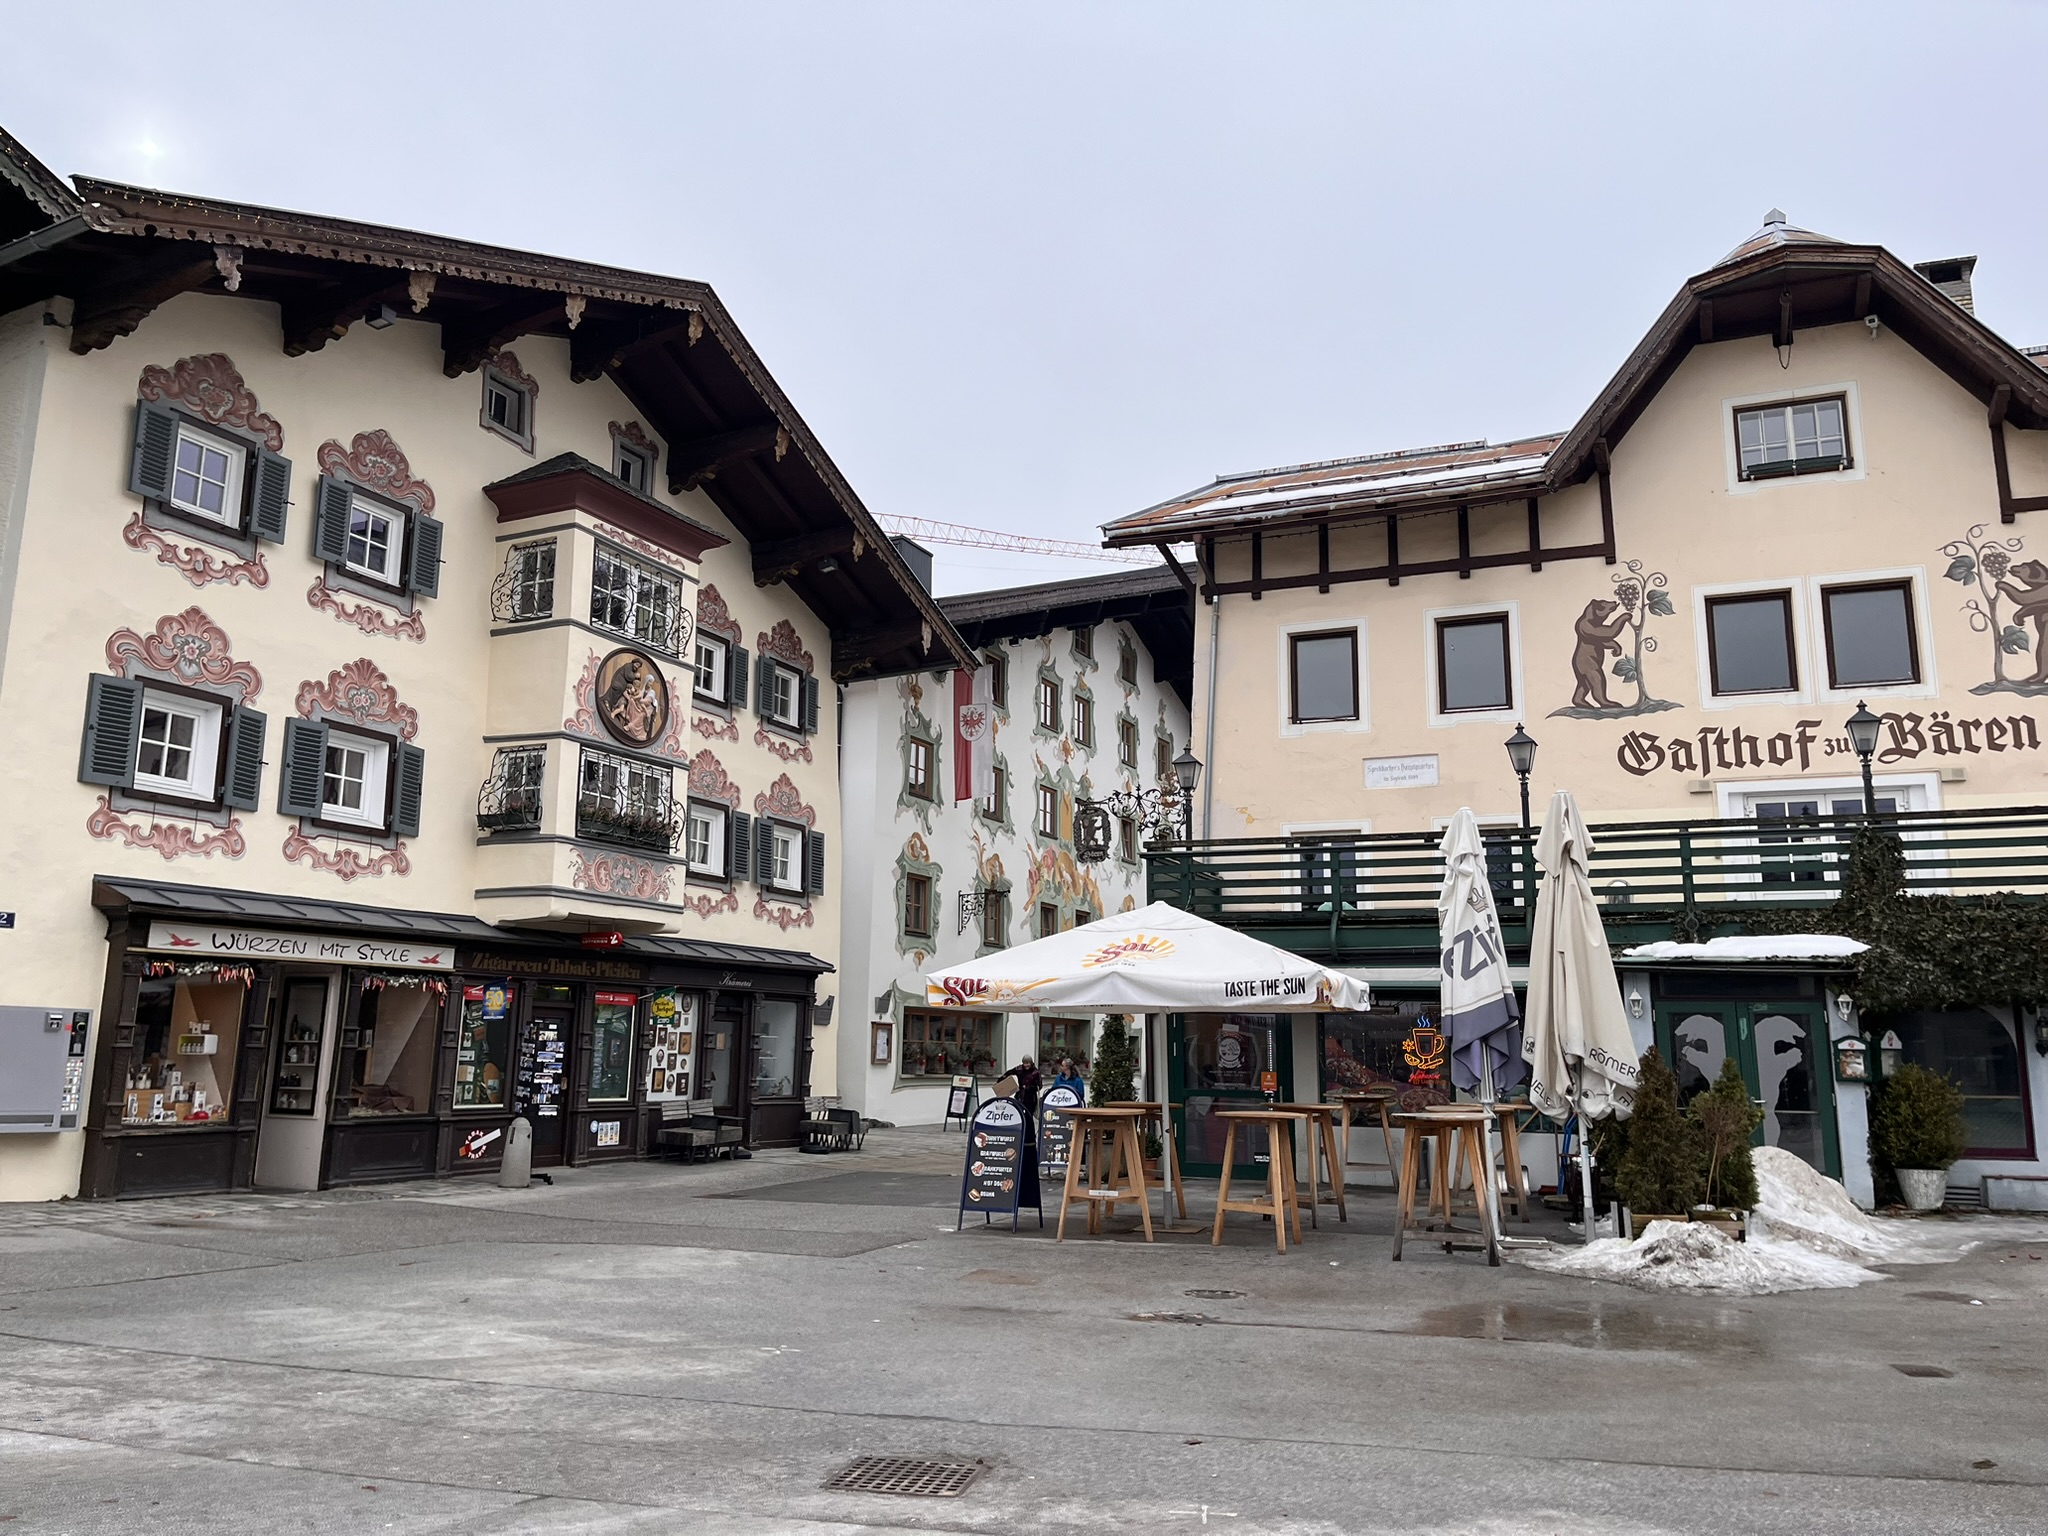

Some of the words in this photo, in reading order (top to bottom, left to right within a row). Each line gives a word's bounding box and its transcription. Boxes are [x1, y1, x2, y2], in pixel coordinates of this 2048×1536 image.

[1877, 710, 2042, 765] Bären
[211, 932, 307, 955] WÜRZEN
[357, 943, 411, 963] STYLE
[1224, 980, 1257, 998] TASTE
[1259, 978, 1280, 996] THE
[1283, 977, 1306, 995] SUN
[1051, 1094, 1073, 1105] Zipfer
[986, 1110, 1014, 1123] Zipfer
